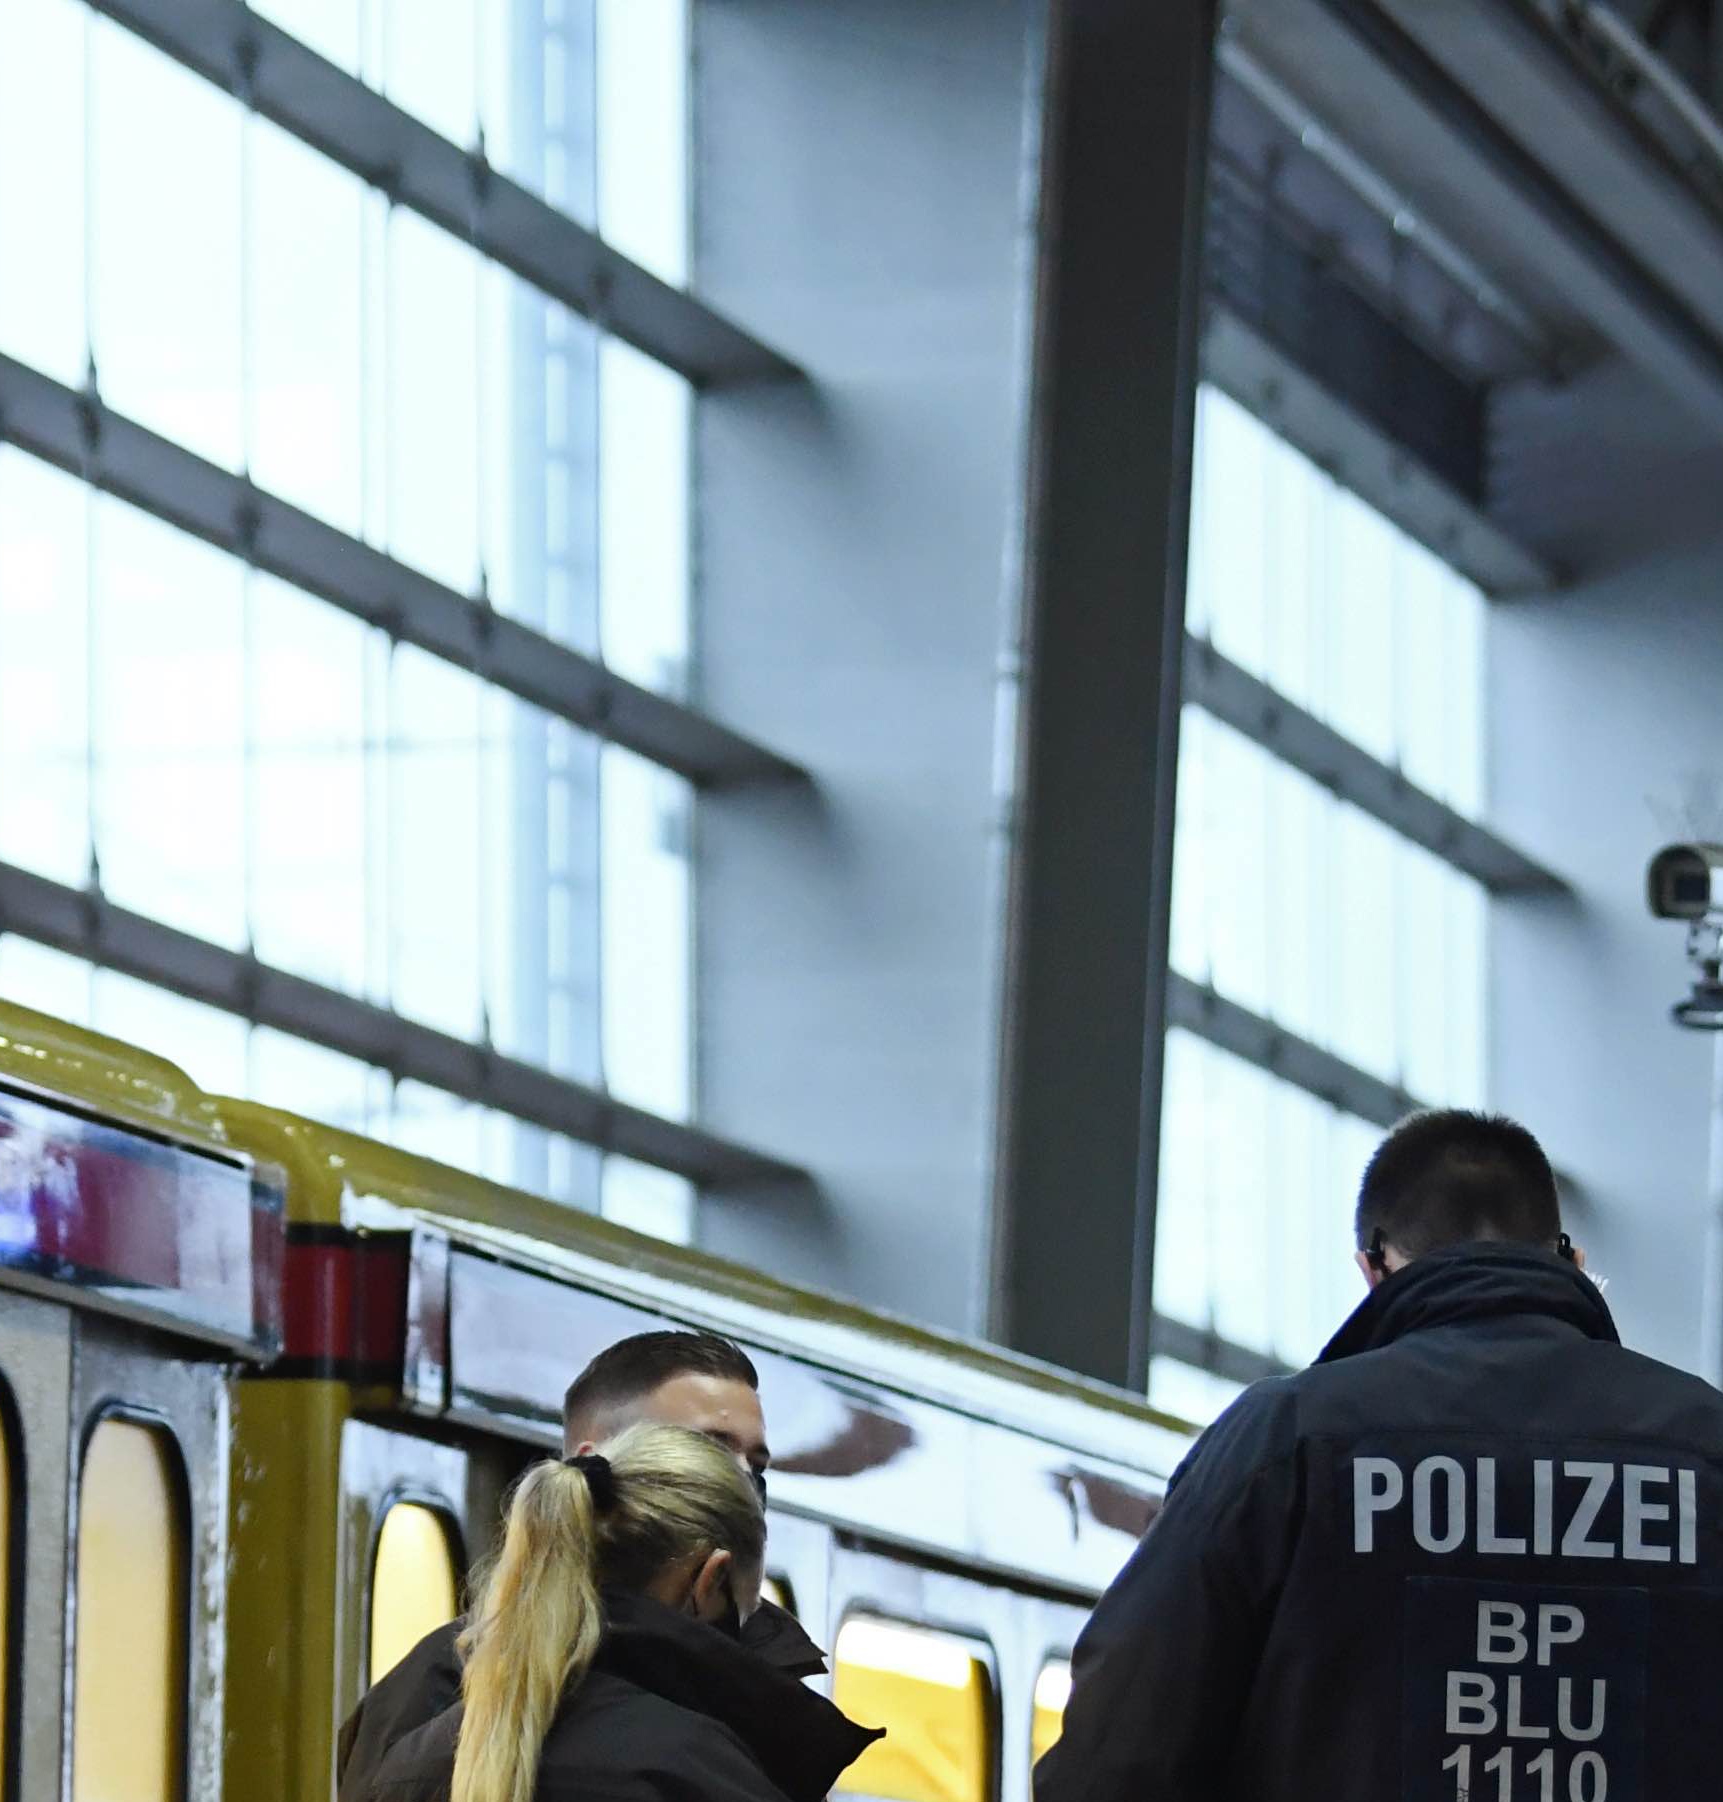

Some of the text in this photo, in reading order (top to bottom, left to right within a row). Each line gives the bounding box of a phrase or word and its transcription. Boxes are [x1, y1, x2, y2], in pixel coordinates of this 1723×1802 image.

[1352, 1455, 1697, 1564] POLIZEI
[1476, 1600, 1585, 1666] BP
[1445, 1670, 1607, 1742] BLU
